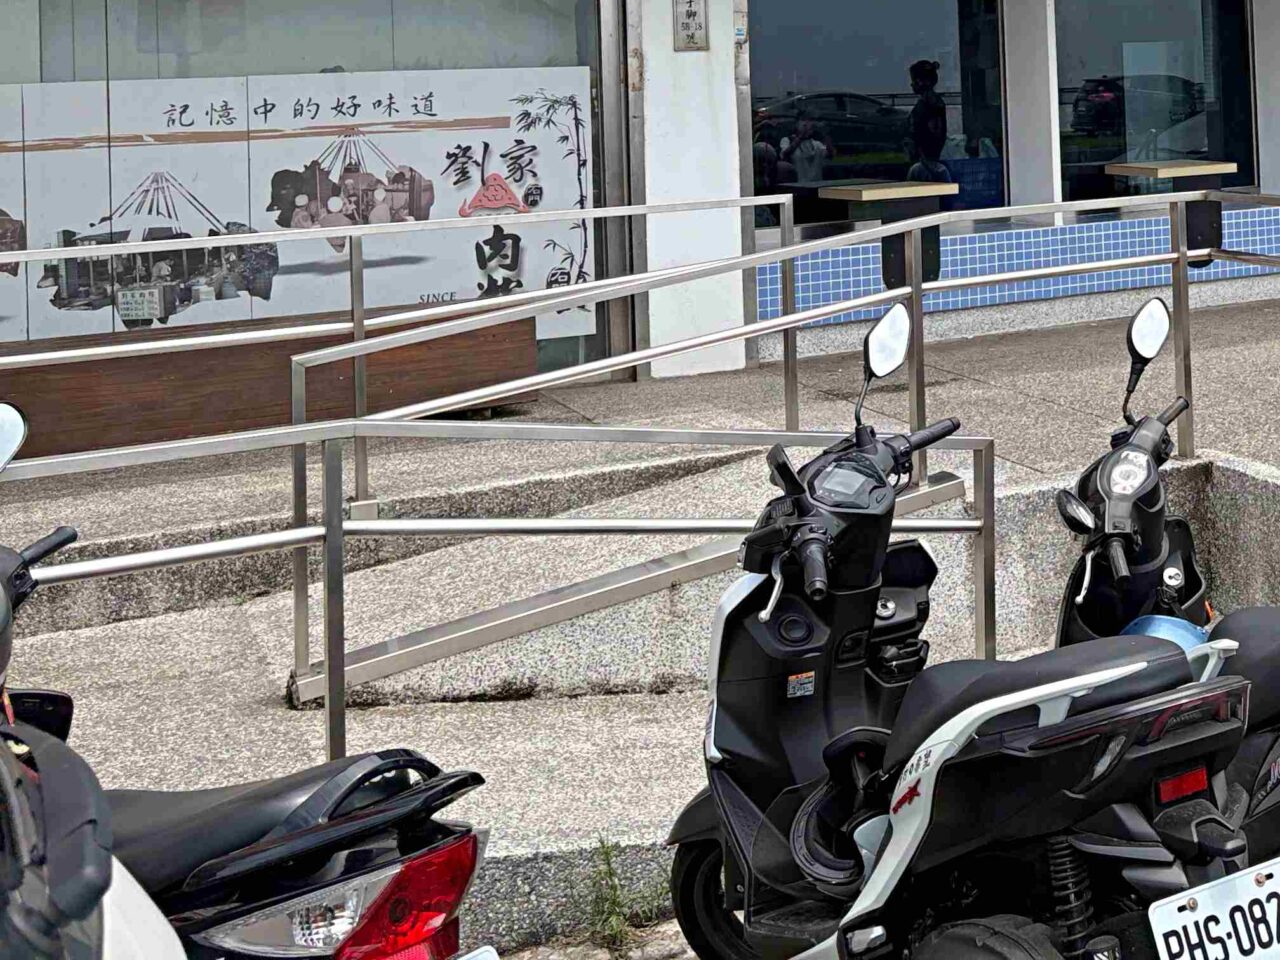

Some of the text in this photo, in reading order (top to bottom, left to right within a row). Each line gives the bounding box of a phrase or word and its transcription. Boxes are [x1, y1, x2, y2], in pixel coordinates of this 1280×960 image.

[163, 92, 438, 128] 記憶中的好味道
[441, 140, 538, 187] 劉家
[419, 292, 457, 304] SINCE
